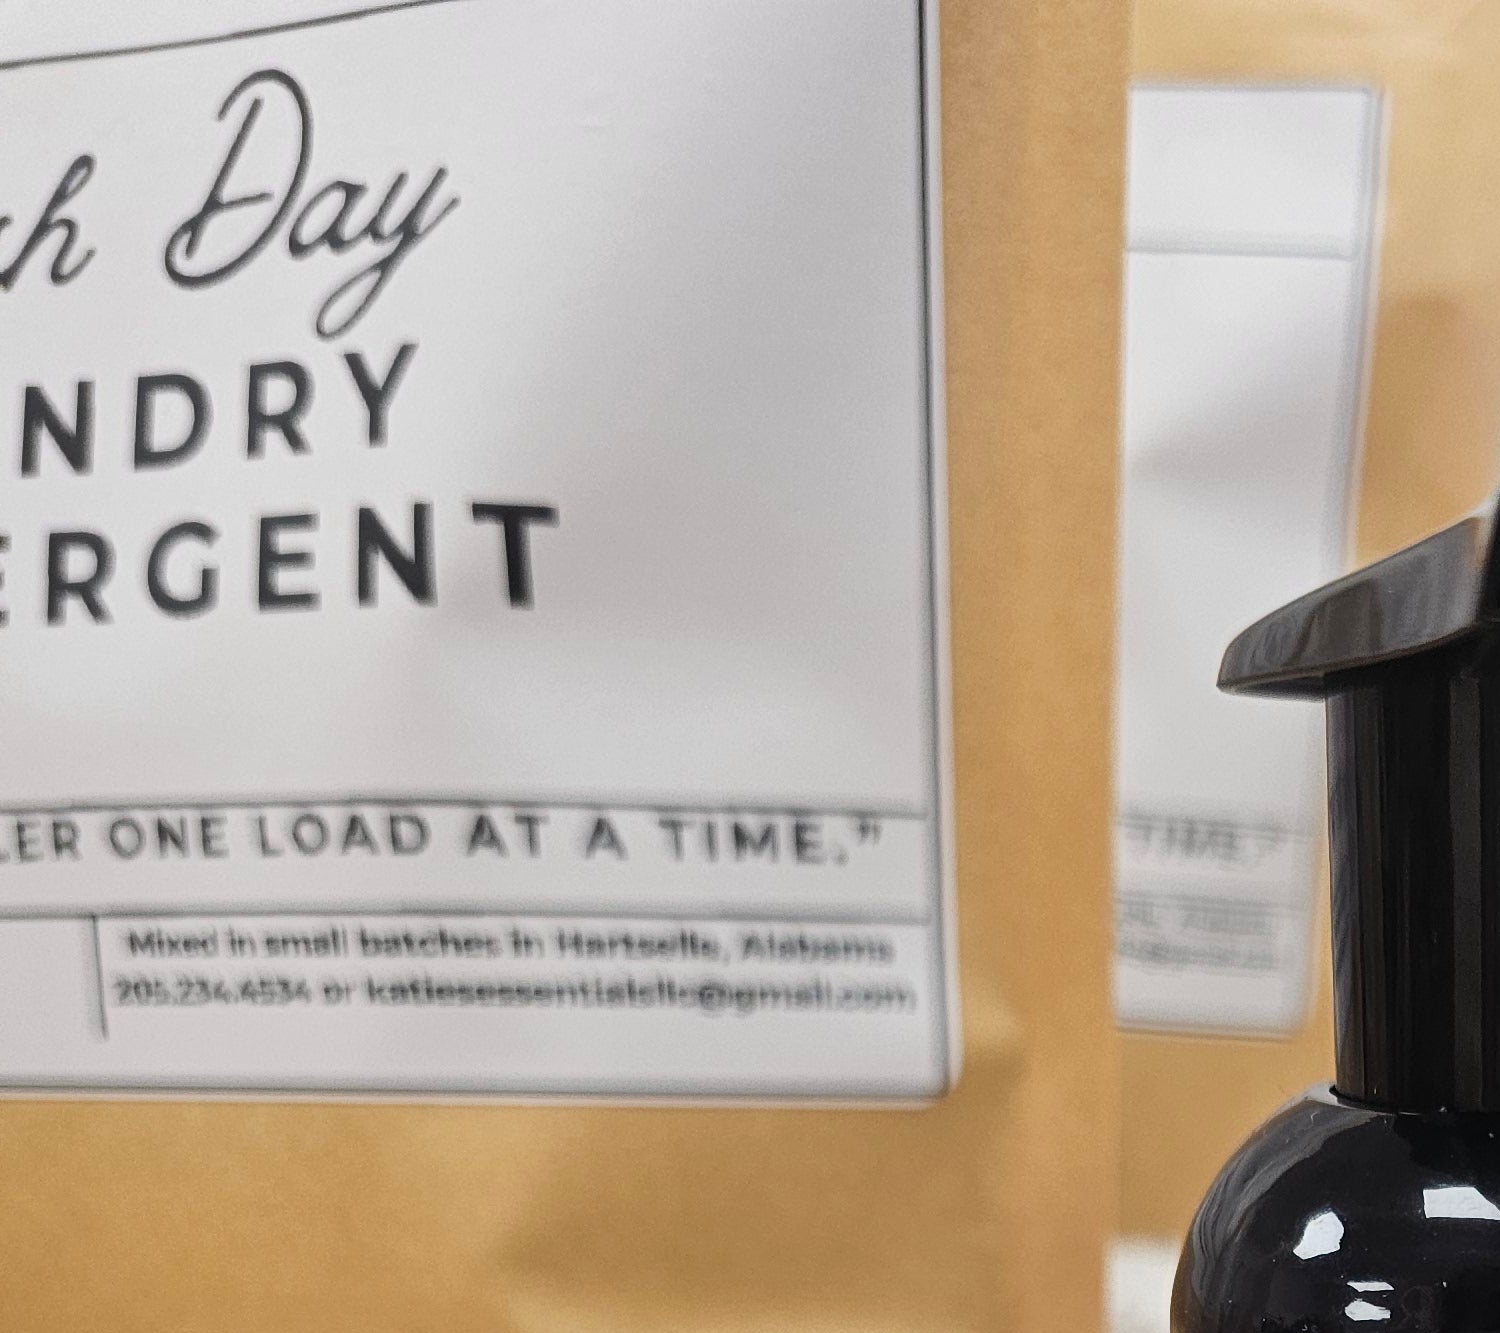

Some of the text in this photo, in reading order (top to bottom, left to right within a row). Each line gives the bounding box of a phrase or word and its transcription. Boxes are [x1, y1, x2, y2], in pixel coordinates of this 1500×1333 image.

[0, 68, 460, 339] h Day
[20, 342, 420, 478] NDRY
[0, 500, 560, 629] RGENT
[0, 820, 82, 863] ER
[109, 816, 228, 860] ONE
[259, 814, 431, 858] LOAD
[466, 814, 549, 859] AT
[586, 816, 628, 861] A
[128, 926, 218, 957] Mixed
[229, 924, 257, 958] in
[265, 923, 348, 958] small
[360, 924, 502, 959] batches
[512, 924, 545, 958] in
[740, 929, 896, 964] Alabama
[322, 980, 353, 1006] or
